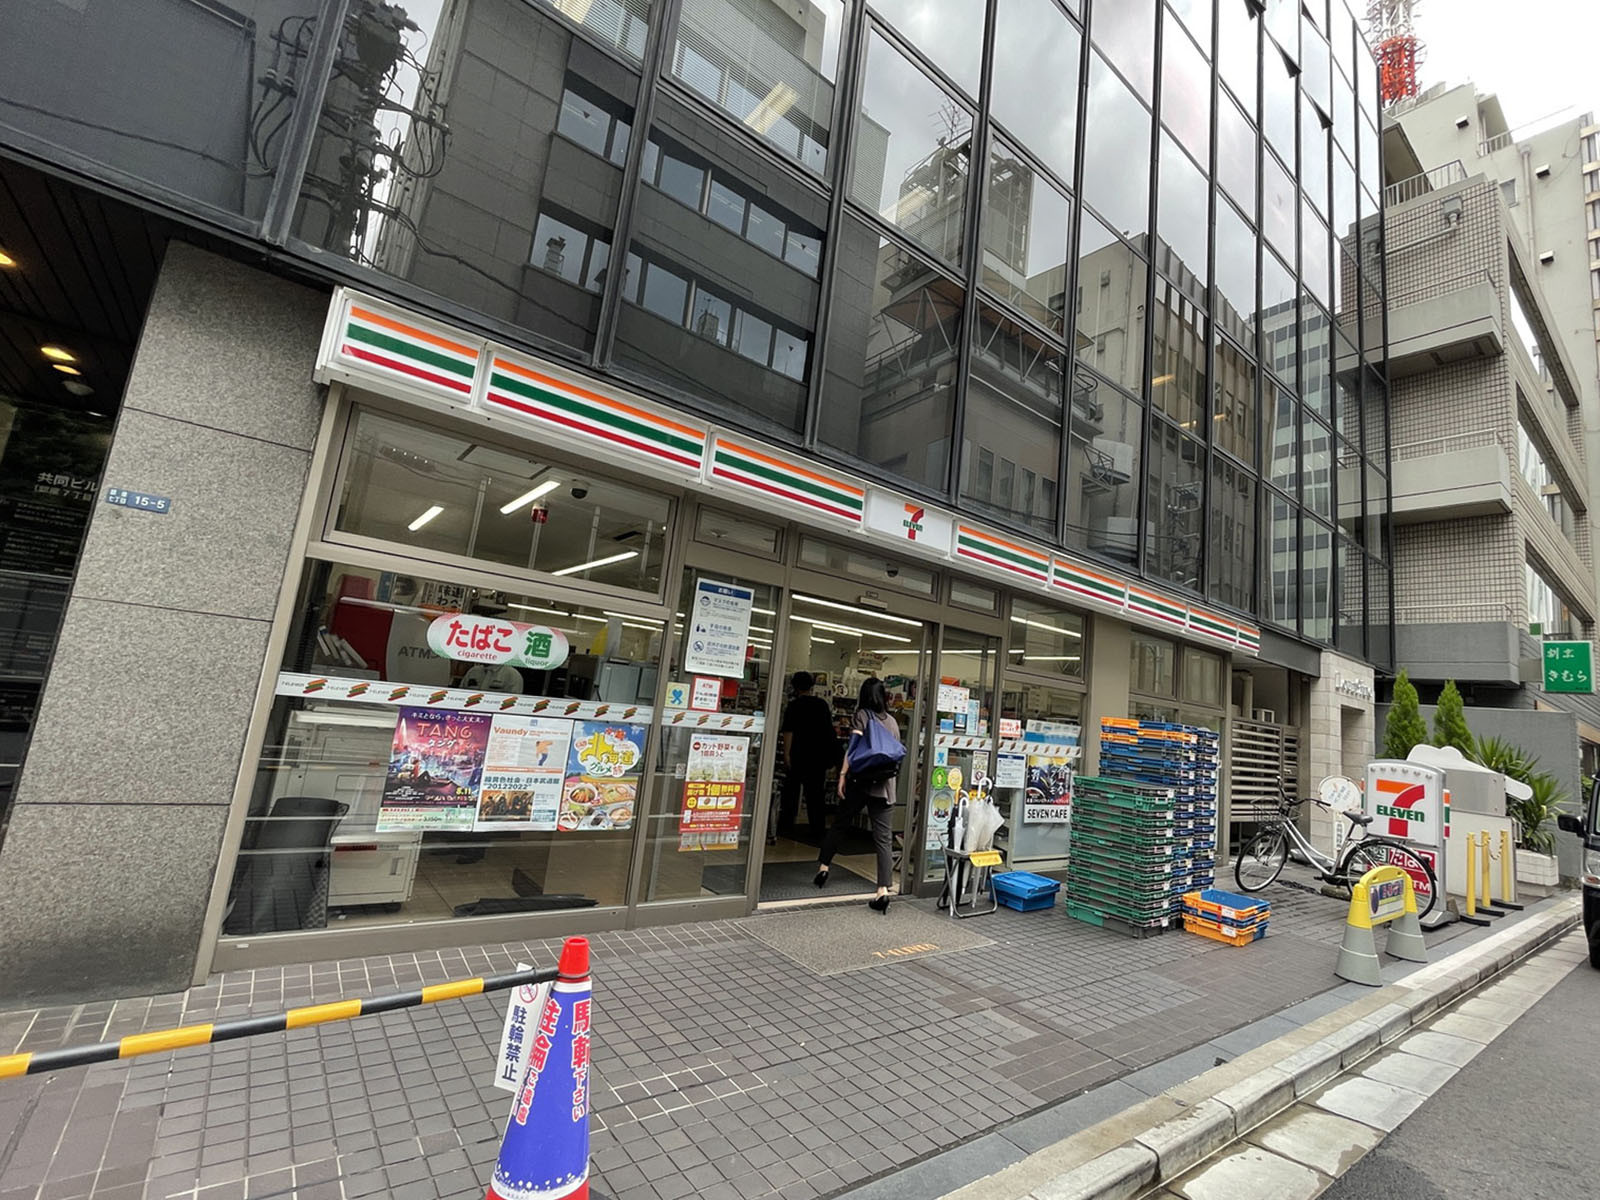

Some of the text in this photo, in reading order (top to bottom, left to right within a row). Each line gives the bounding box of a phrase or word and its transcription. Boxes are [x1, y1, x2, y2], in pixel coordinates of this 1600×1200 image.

[135, 496, 166, 509] 15-5
[446, 620, 553, 659] たばこ 酒
[457, 649, 549, 667] cigarette liquor
[1548, 670, 1589, 682] きむら
[416, 722, 472, 740] TANG
[494, 726, 528, 737] Vaundy
[1027, 808, 1050, 819] SEVEN
[501, 1004, 528, 1083] 駐輪禁止
